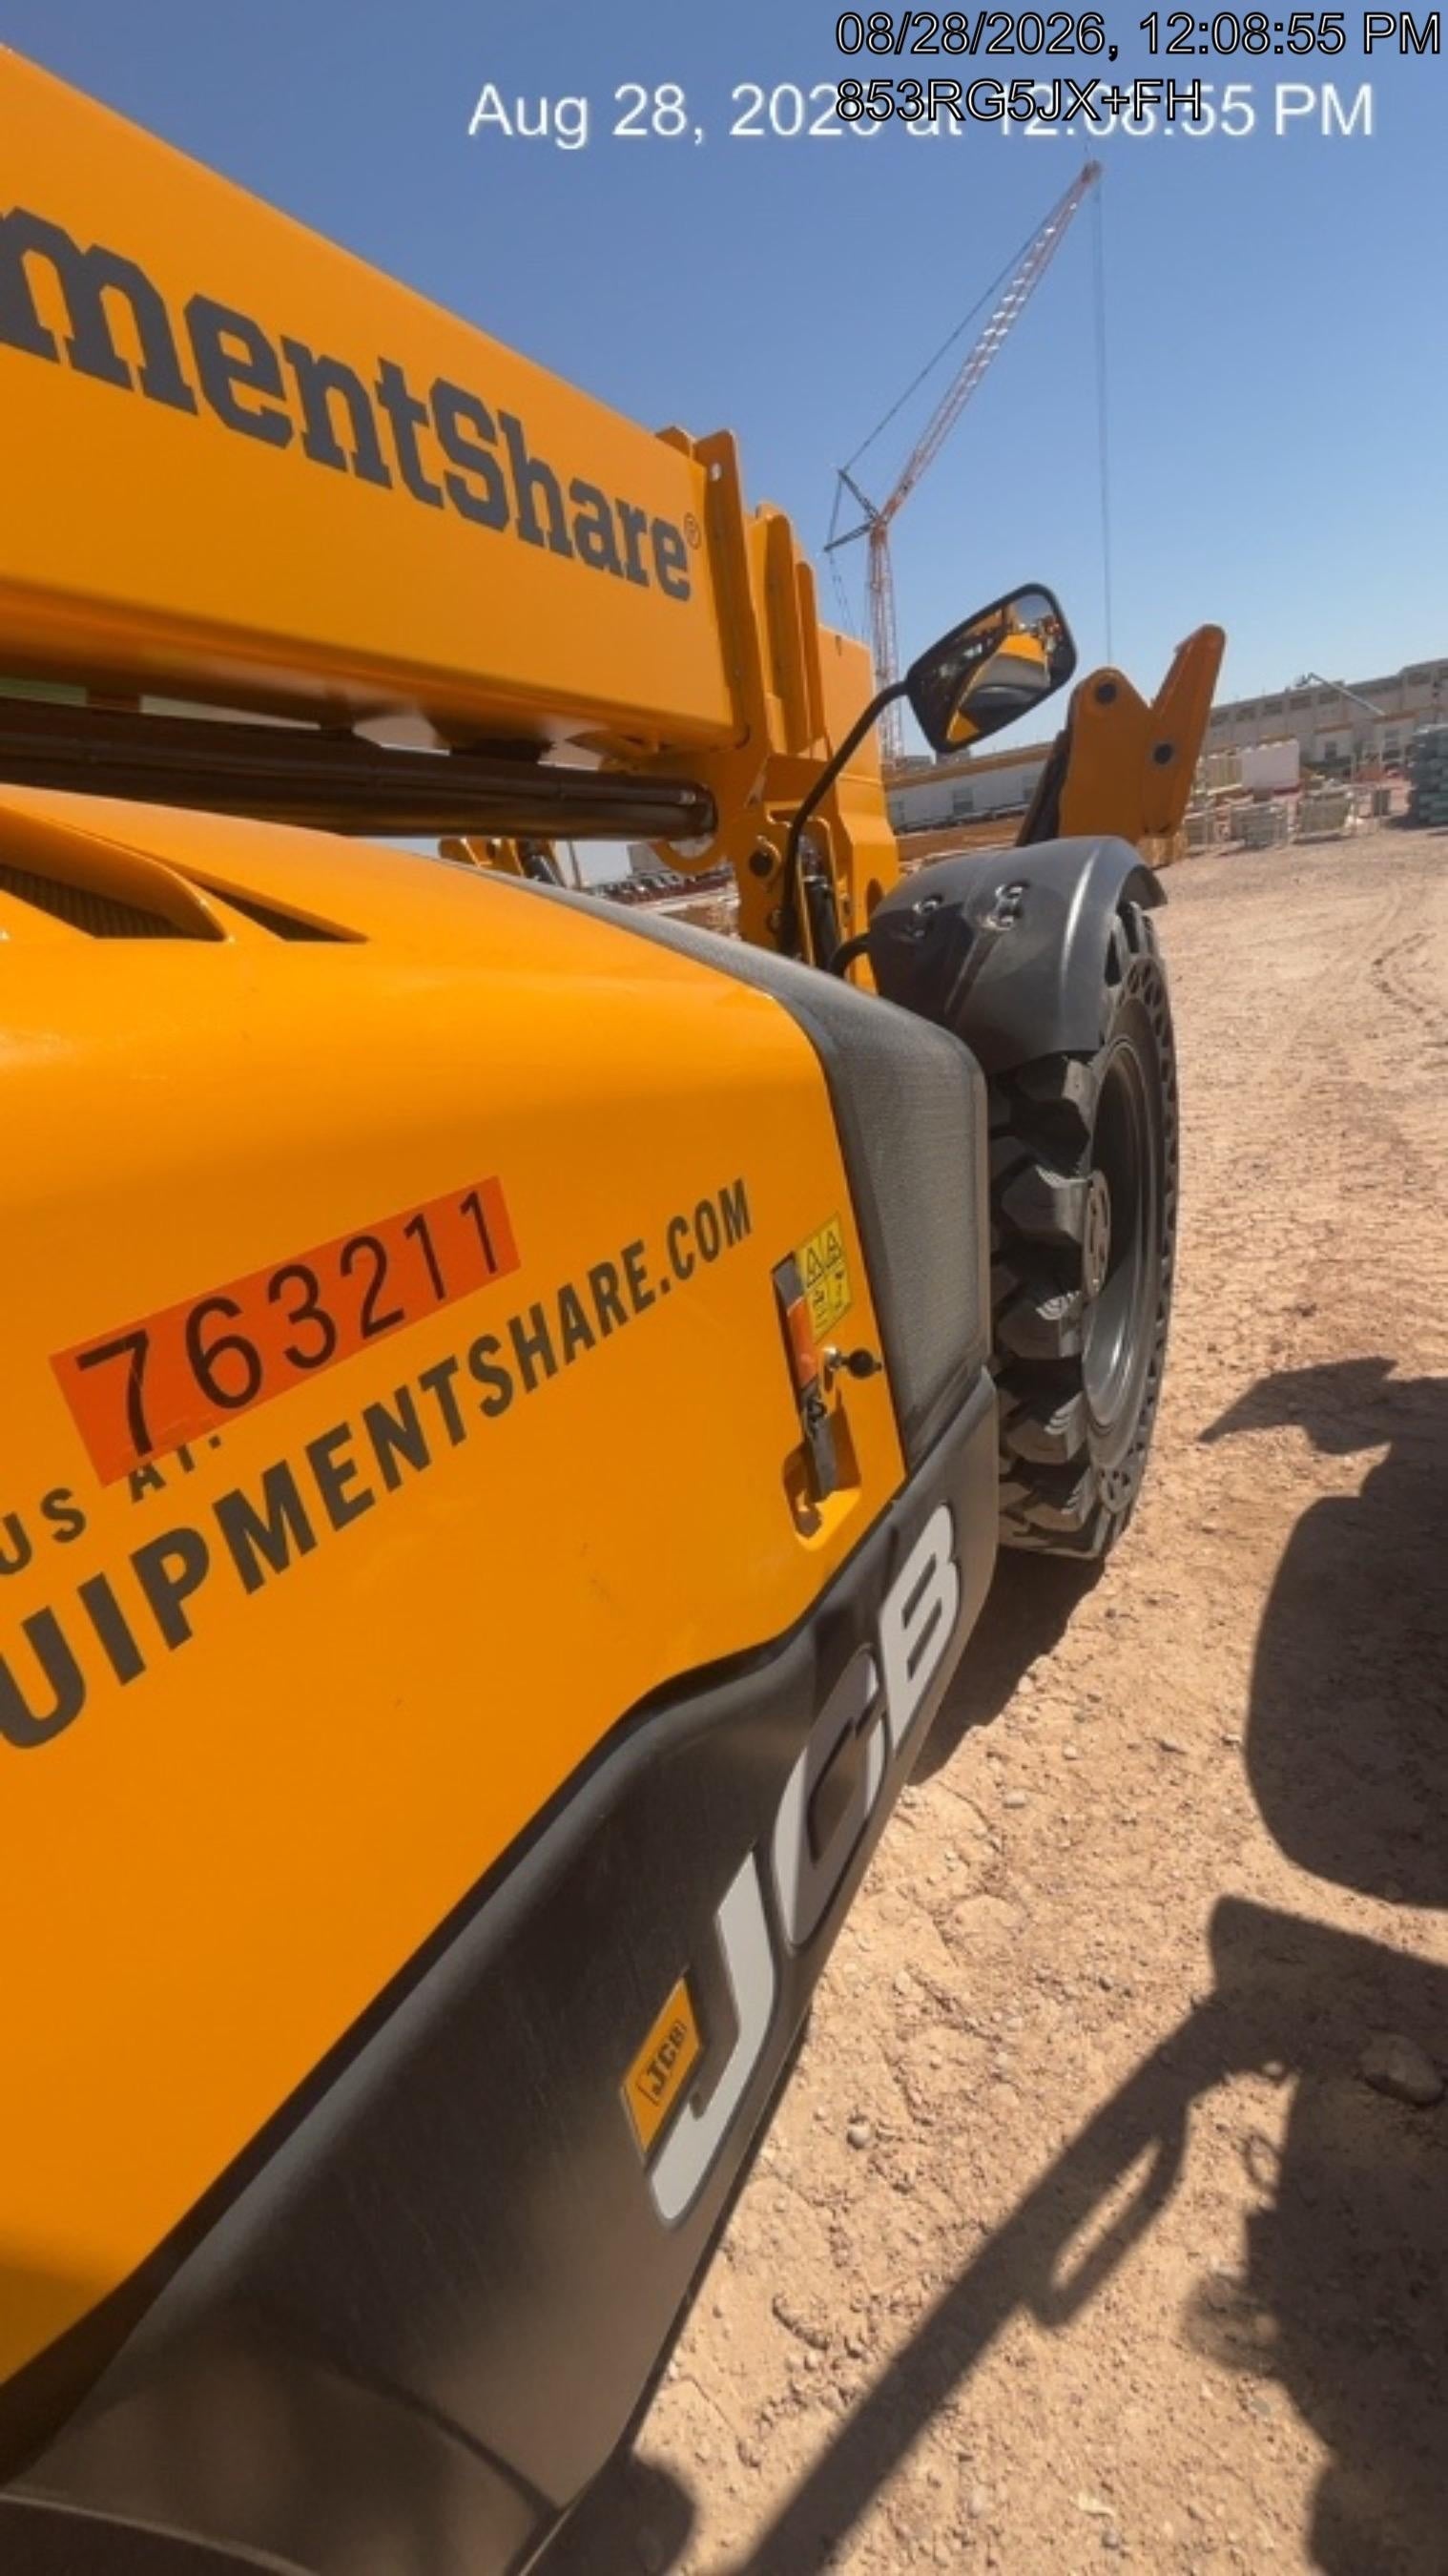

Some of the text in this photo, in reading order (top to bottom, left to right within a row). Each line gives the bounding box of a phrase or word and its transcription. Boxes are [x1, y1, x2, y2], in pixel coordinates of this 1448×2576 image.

[75, 1189, 500, 1457] 763211
[651, 1502, 960, 2220] JCB
[647, 2018, 688, 2097] JCB
